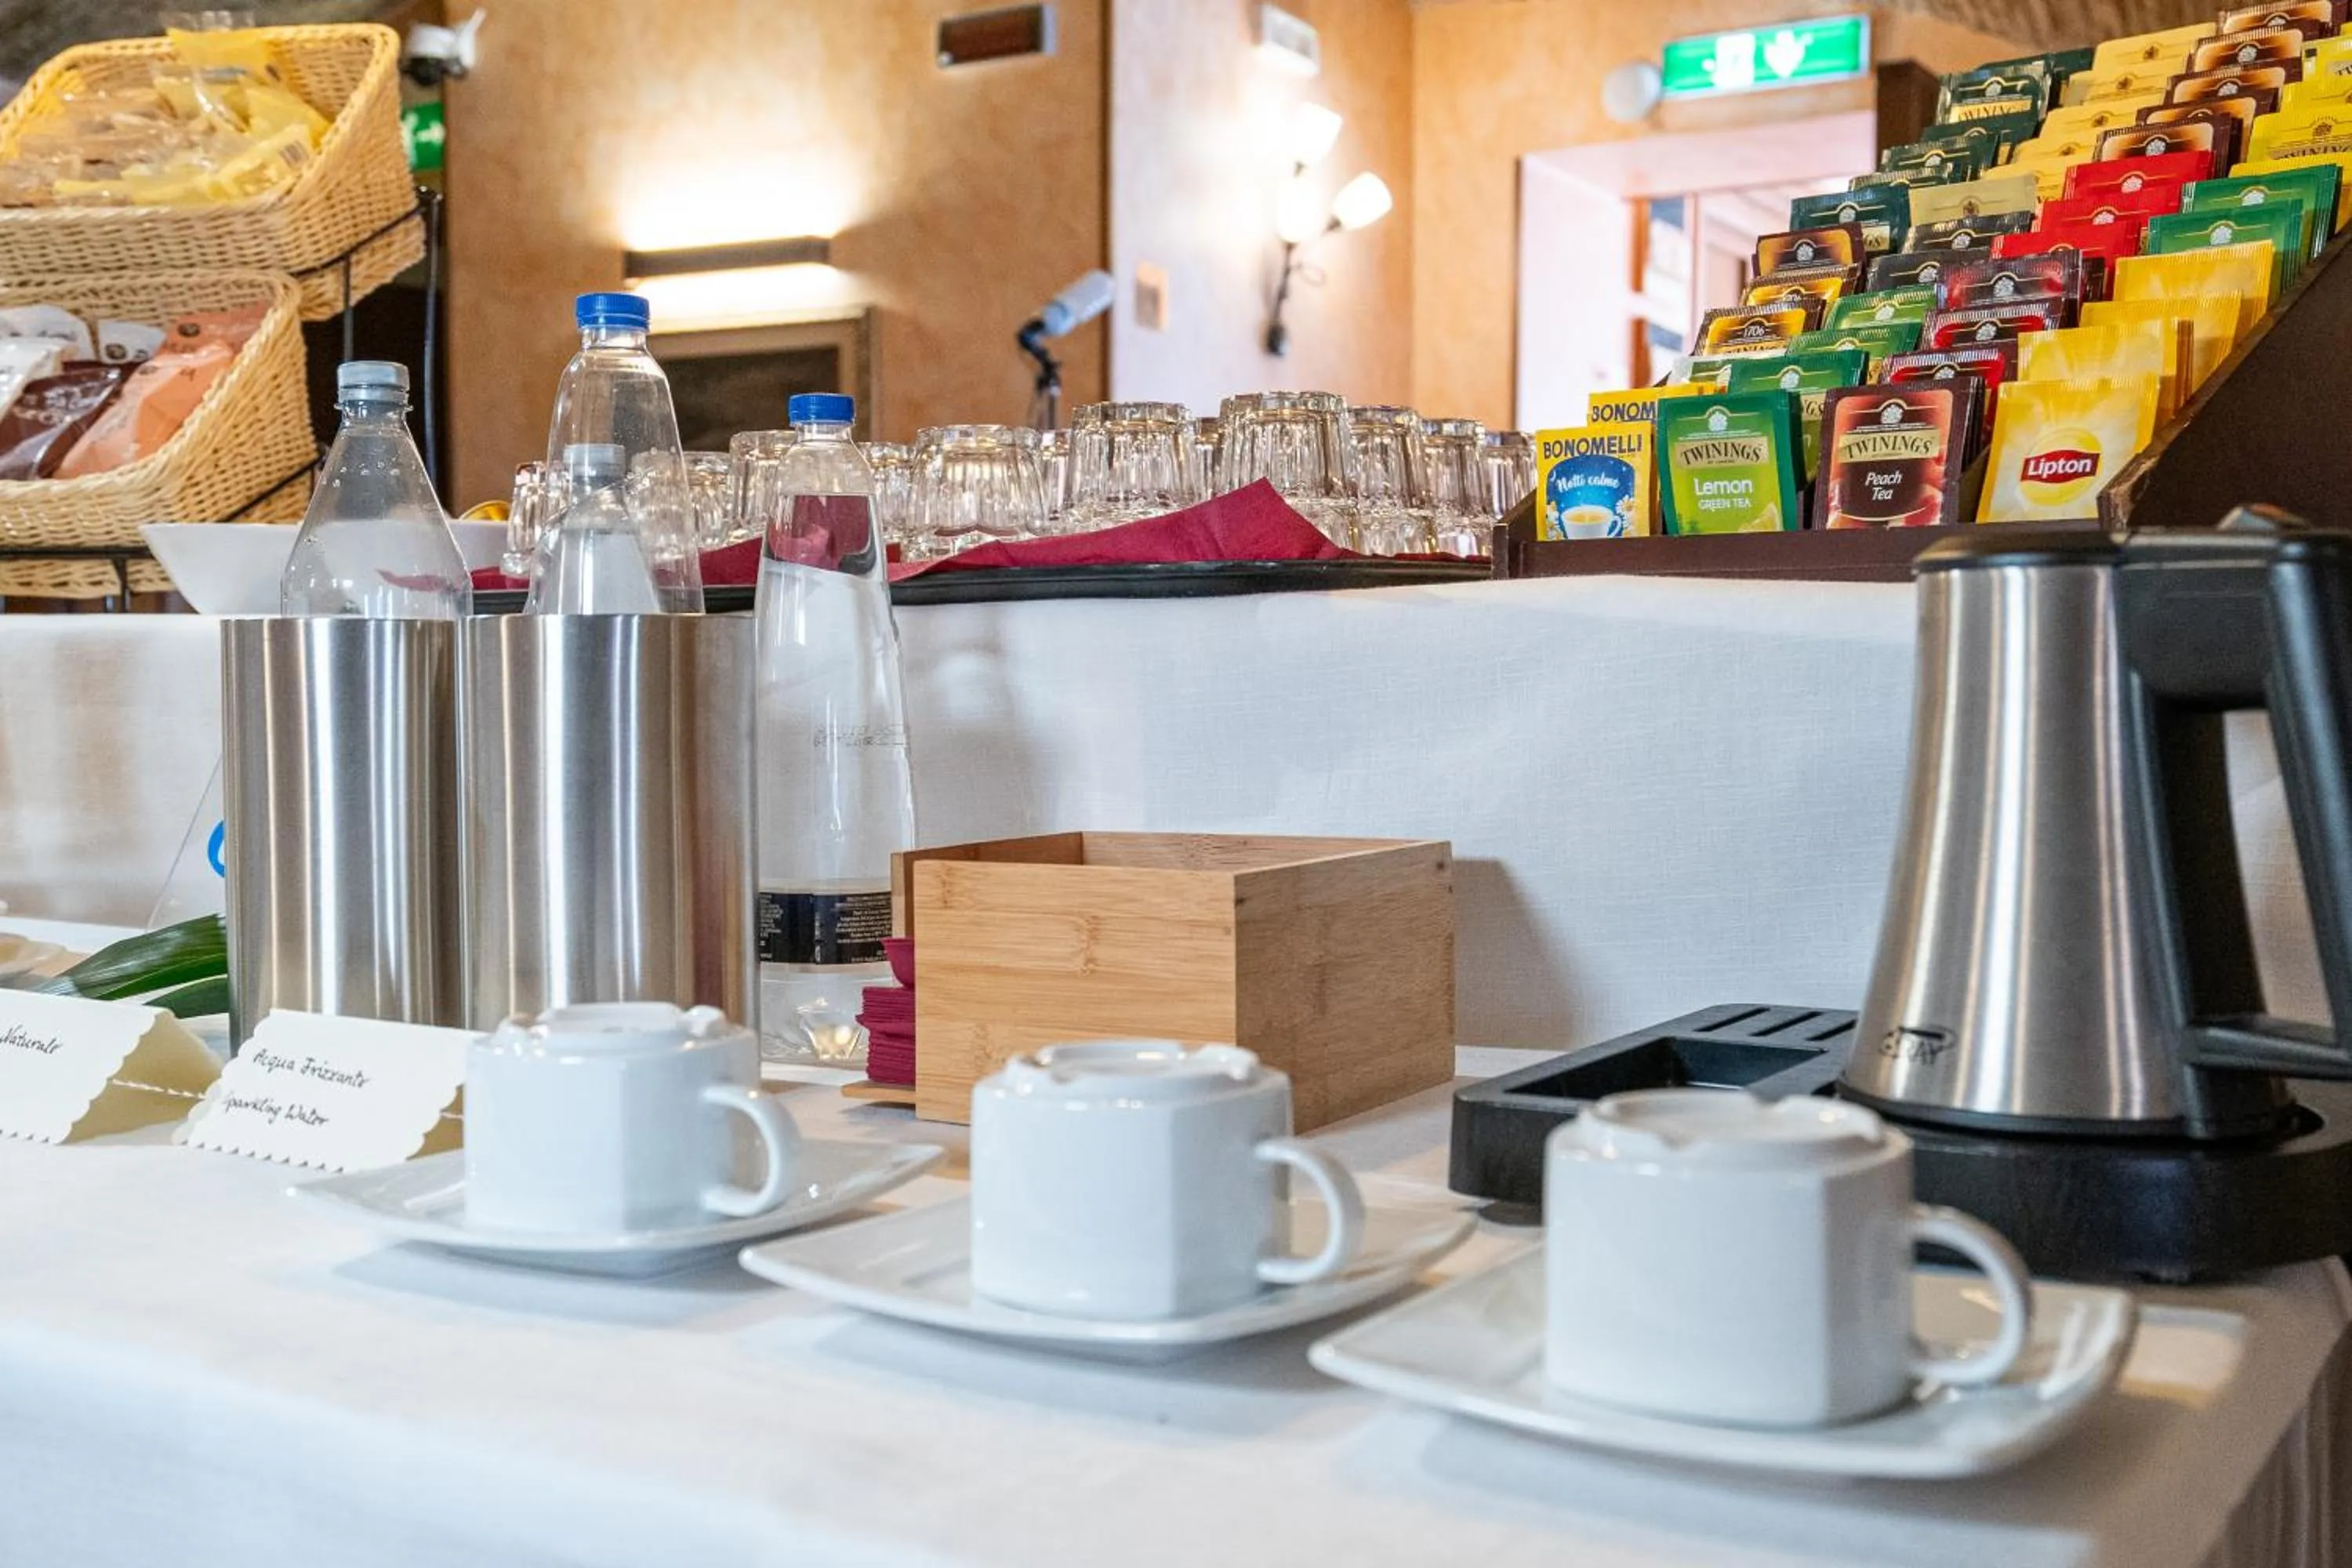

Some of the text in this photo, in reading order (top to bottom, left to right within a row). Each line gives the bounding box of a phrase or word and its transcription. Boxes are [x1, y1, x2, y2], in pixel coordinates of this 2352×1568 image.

[1744, 325, 1766, 338] 1706
[1592, 401, 1656, 423] BONOM
[1543, 434, 1643, 459] BONOMELLI
[1681, 441, 1762, 466] TWININGS
[1845, 435, 1933, 459] TWININGS
[1865, 470, 1903, 486] Peach
[2027, 458, 2092, 479] Lipton
[1555, 472, 1620, 493] Notti calme
[1693, 477, 1753, 495] Lemon
[1698, 497, 1752, 511] GREEN TEA
[1872, 487, 1893, 500] Tea
[253, 1047, 372, 1088] Acqua Frizzante
[284, 1103, 330, 1126] Water
